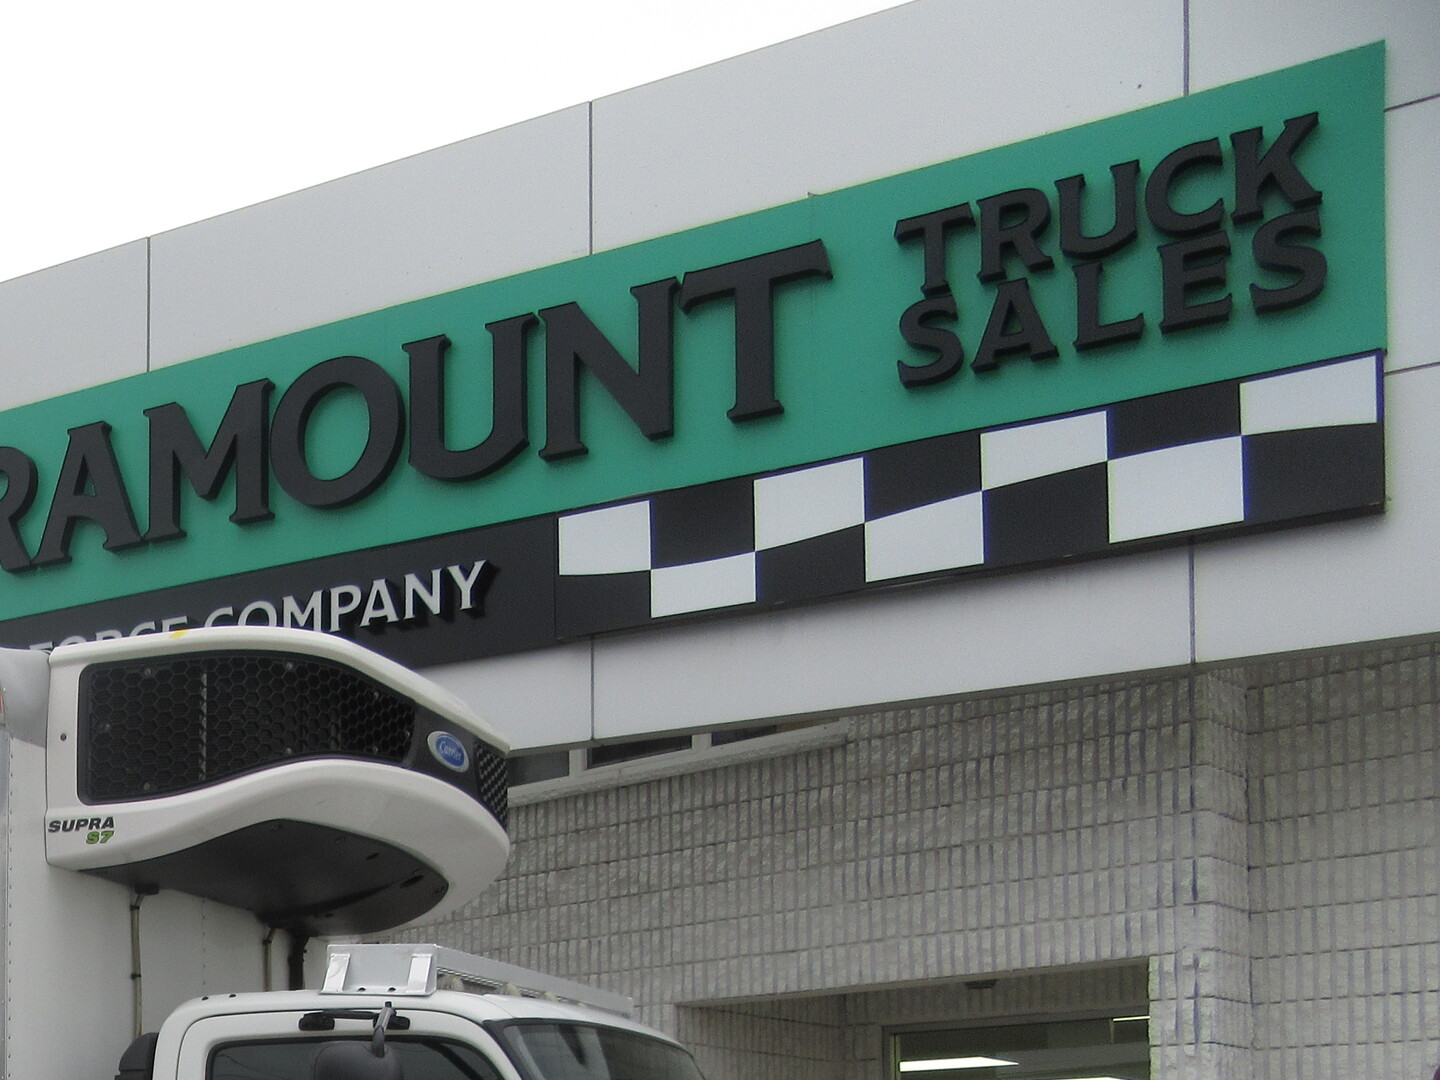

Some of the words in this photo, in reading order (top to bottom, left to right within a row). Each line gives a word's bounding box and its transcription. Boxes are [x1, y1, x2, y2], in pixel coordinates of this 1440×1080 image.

[893, 112, 1324, 297] TRUCK
[896, 209, 1329, 388] SALES
[47, 816, 115, 833] SUPRA
[85, 830, 115, 845] S7
